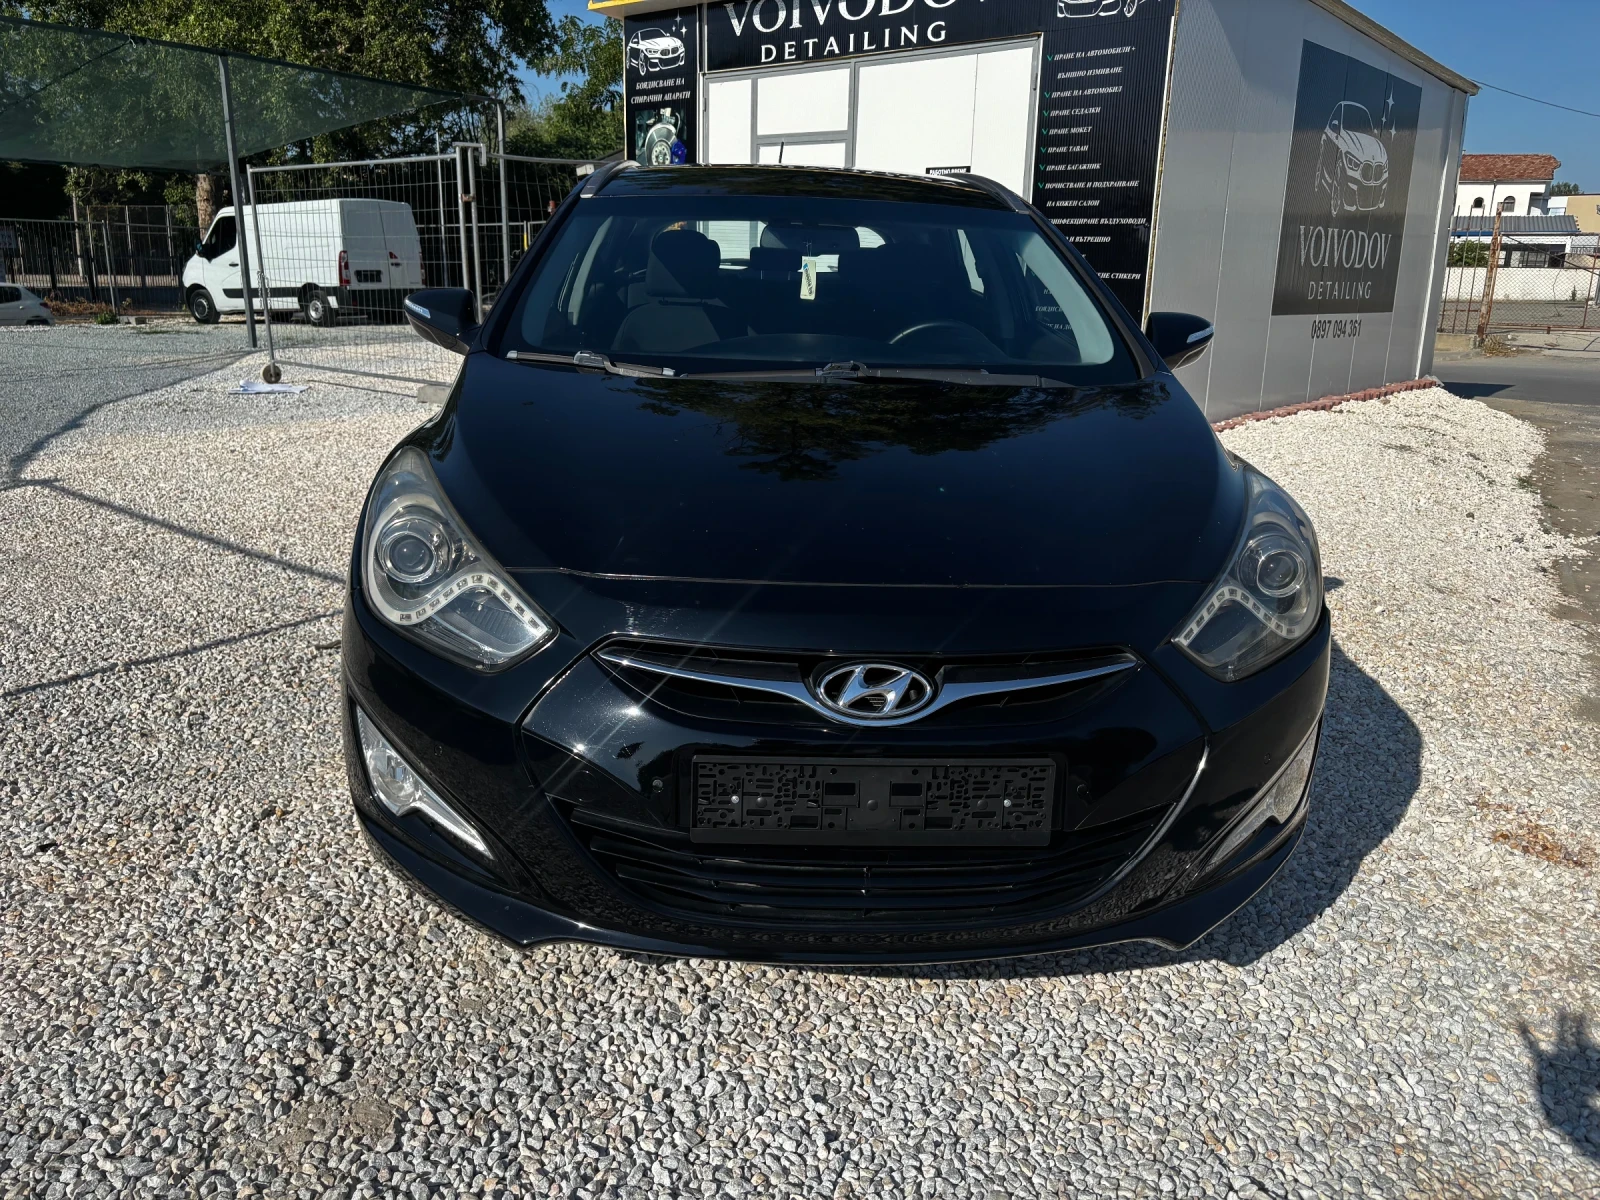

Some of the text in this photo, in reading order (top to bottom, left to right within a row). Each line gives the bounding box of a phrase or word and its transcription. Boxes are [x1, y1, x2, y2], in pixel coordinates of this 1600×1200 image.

[724, 0, 985, 37] VOIVOD
[760, 21, 947, 63] DETAILING
[1300, 225, 1392, 270] VOIVODOV
[1308, 281, 1372, 300] DETAILING
[1311, 319, 1362, 339] 0897 094 361
